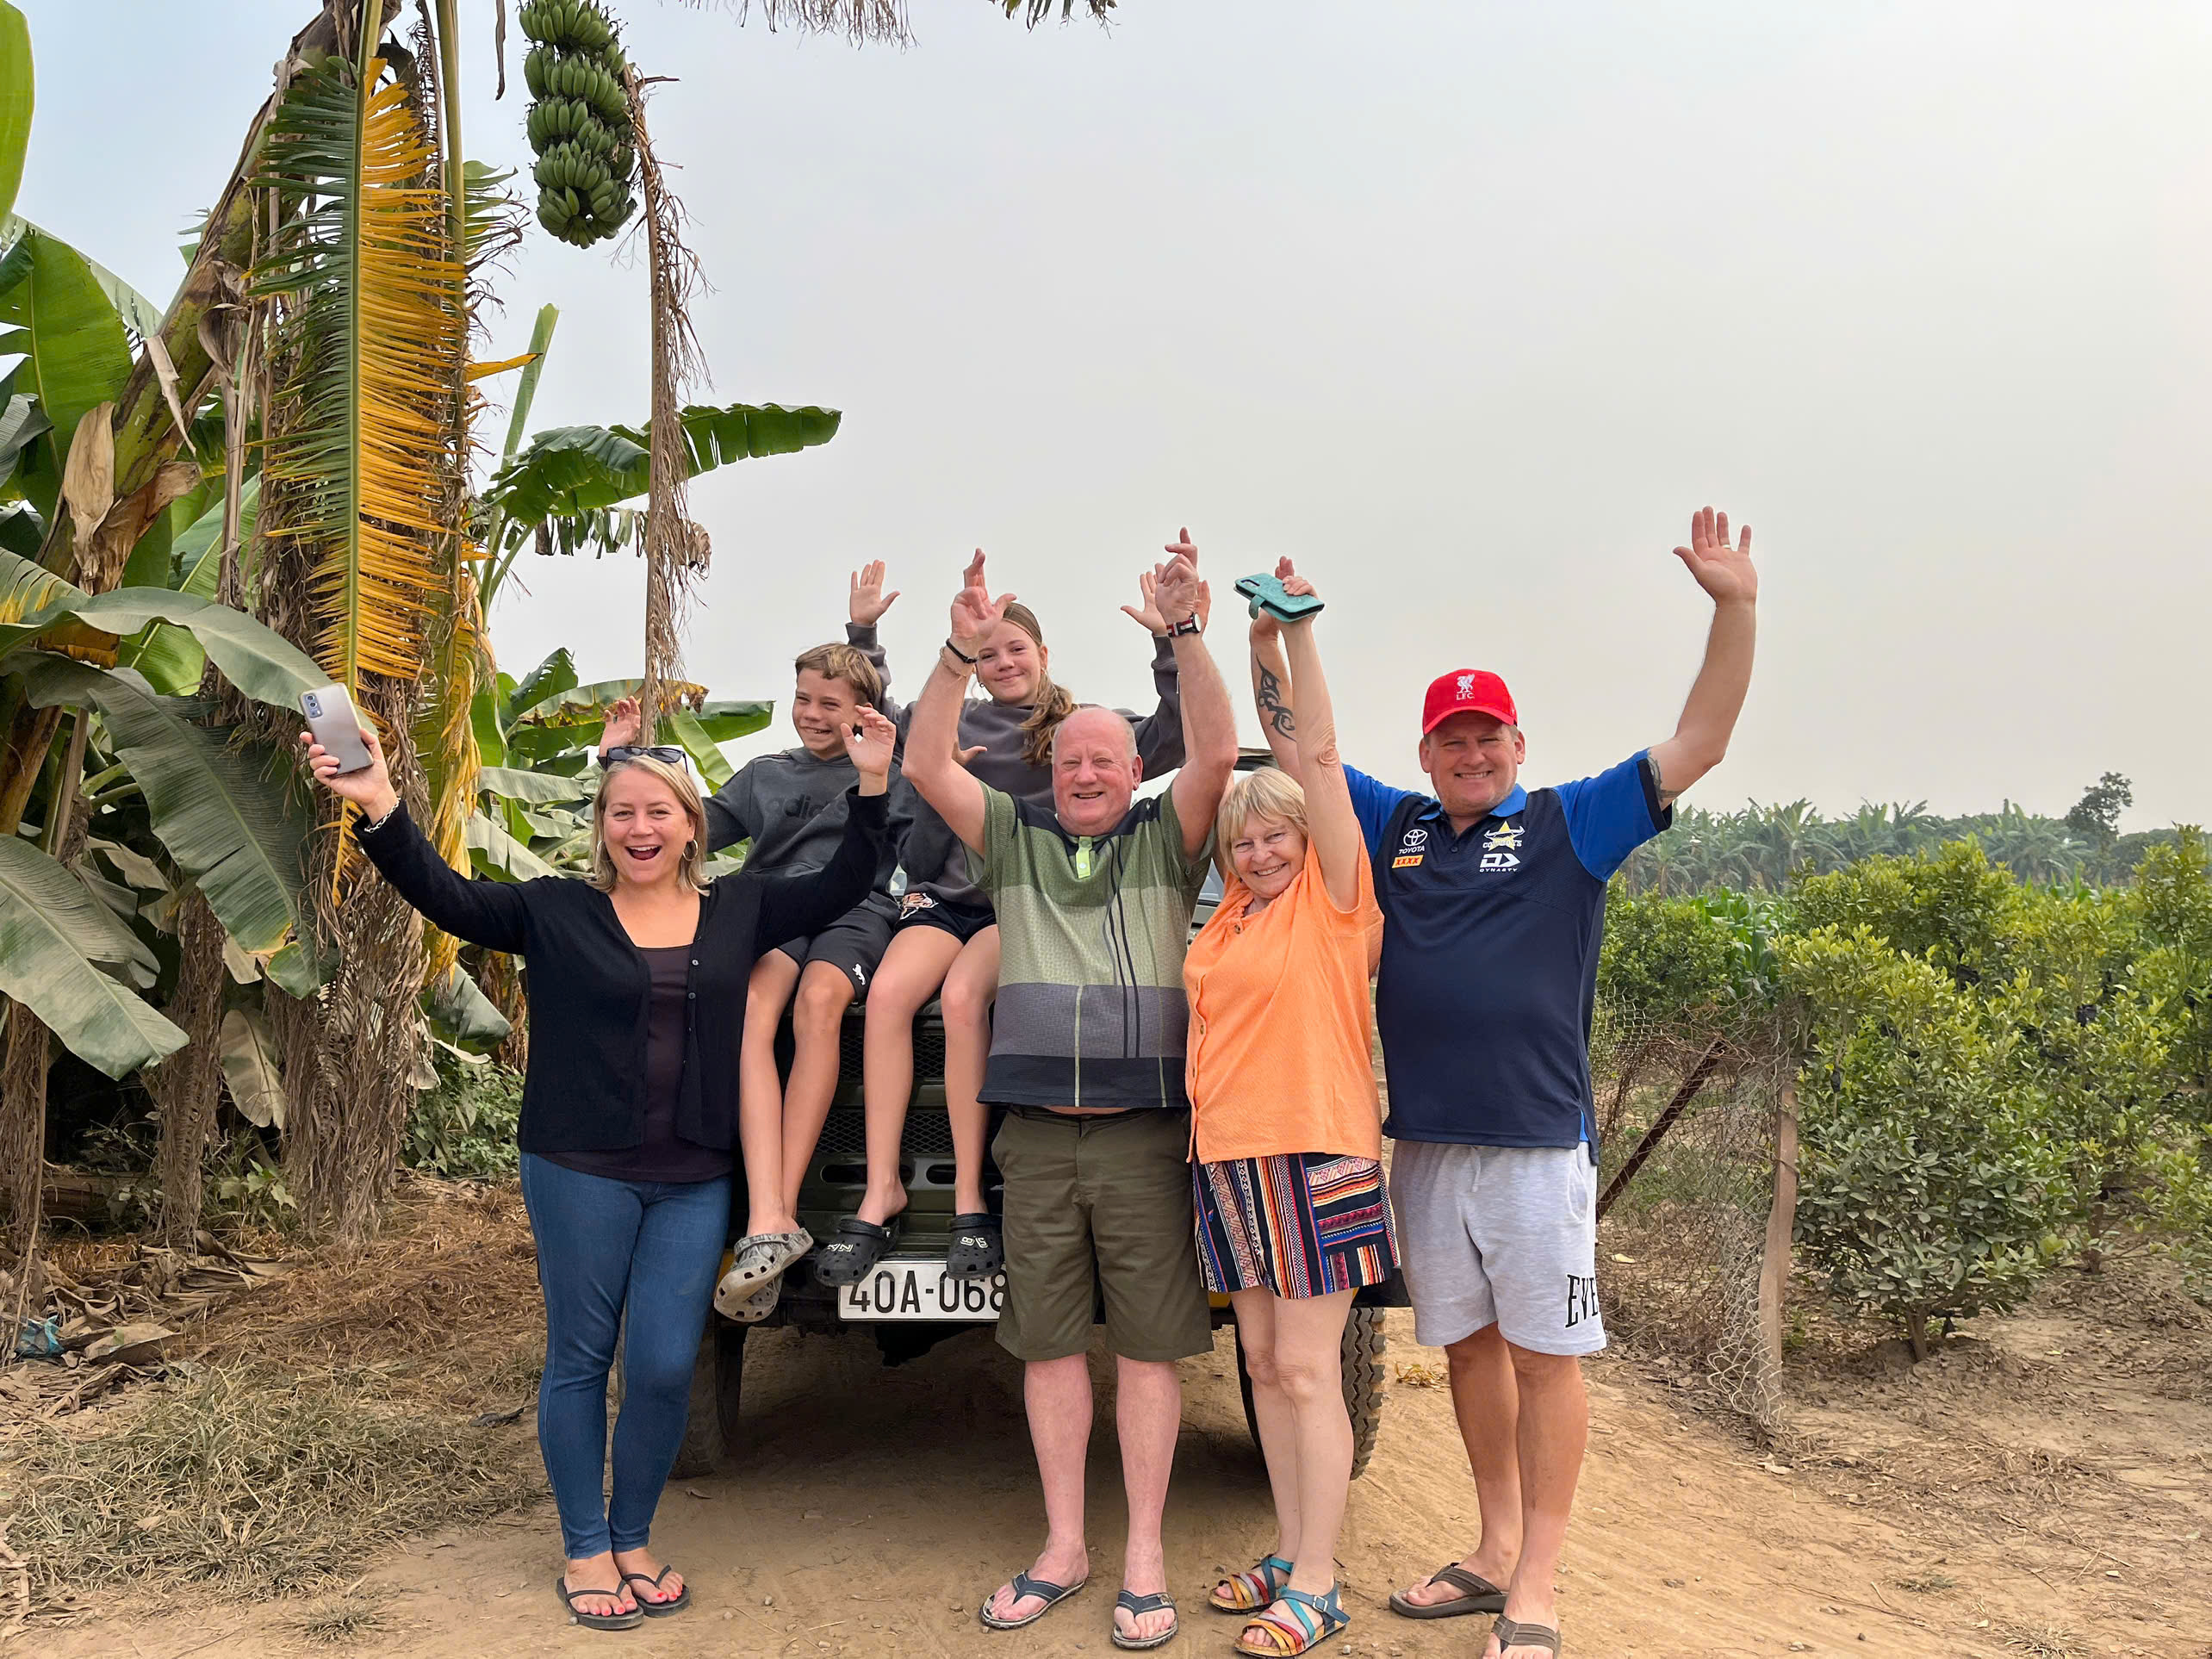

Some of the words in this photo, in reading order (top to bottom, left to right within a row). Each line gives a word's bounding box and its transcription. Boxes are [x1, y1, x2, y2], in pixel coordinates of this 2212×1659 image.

[1456, 693, 1476, 701] LFC
[1398, 845, 1426, 854] TOYOTA
[1395, 857, 1420, 866] XXXX
